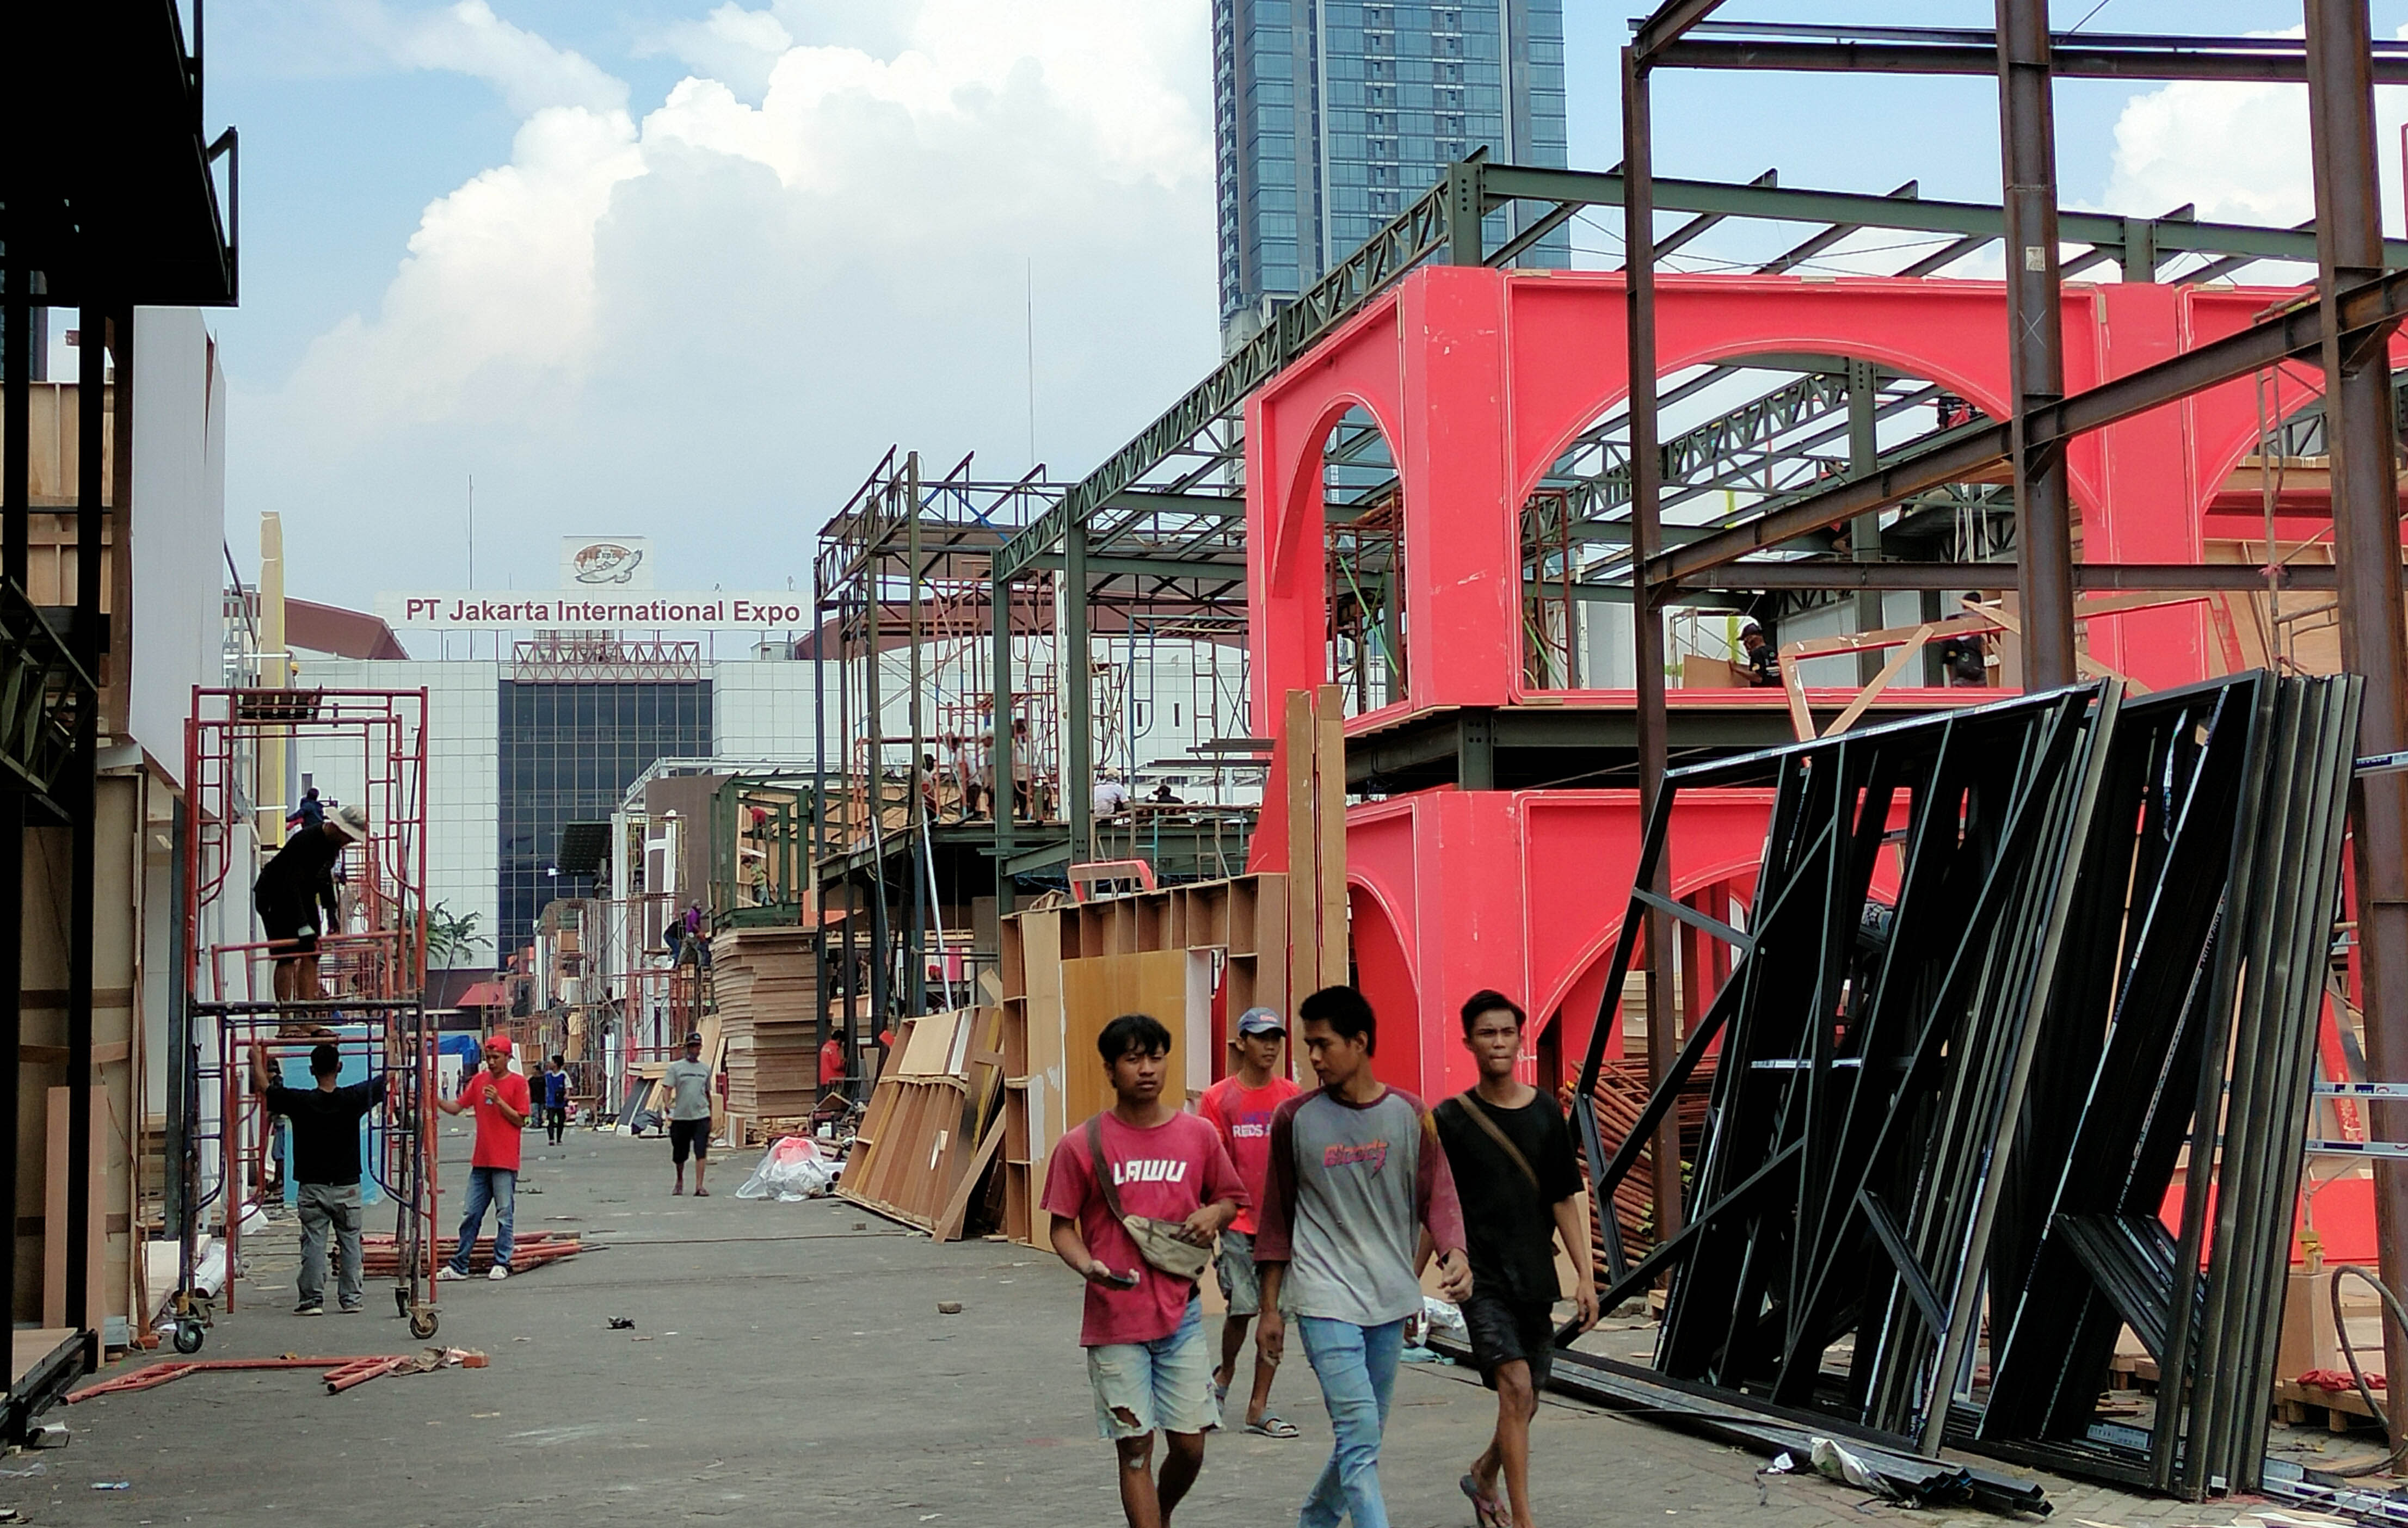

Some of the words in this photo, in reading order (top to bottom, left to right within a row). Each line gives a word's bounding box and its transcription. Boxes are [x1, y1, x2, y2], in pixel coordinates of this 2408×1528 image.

[407, 599, 441, 620] PT
[449, 599, 549, 621] Jakarta
[558, 600, 724, 621] International
[734, 601, 800, 626] Expo
[1232, 1124, 1264, 1138] REDS
[1113, 1160, 1187, 1186] LAWU
